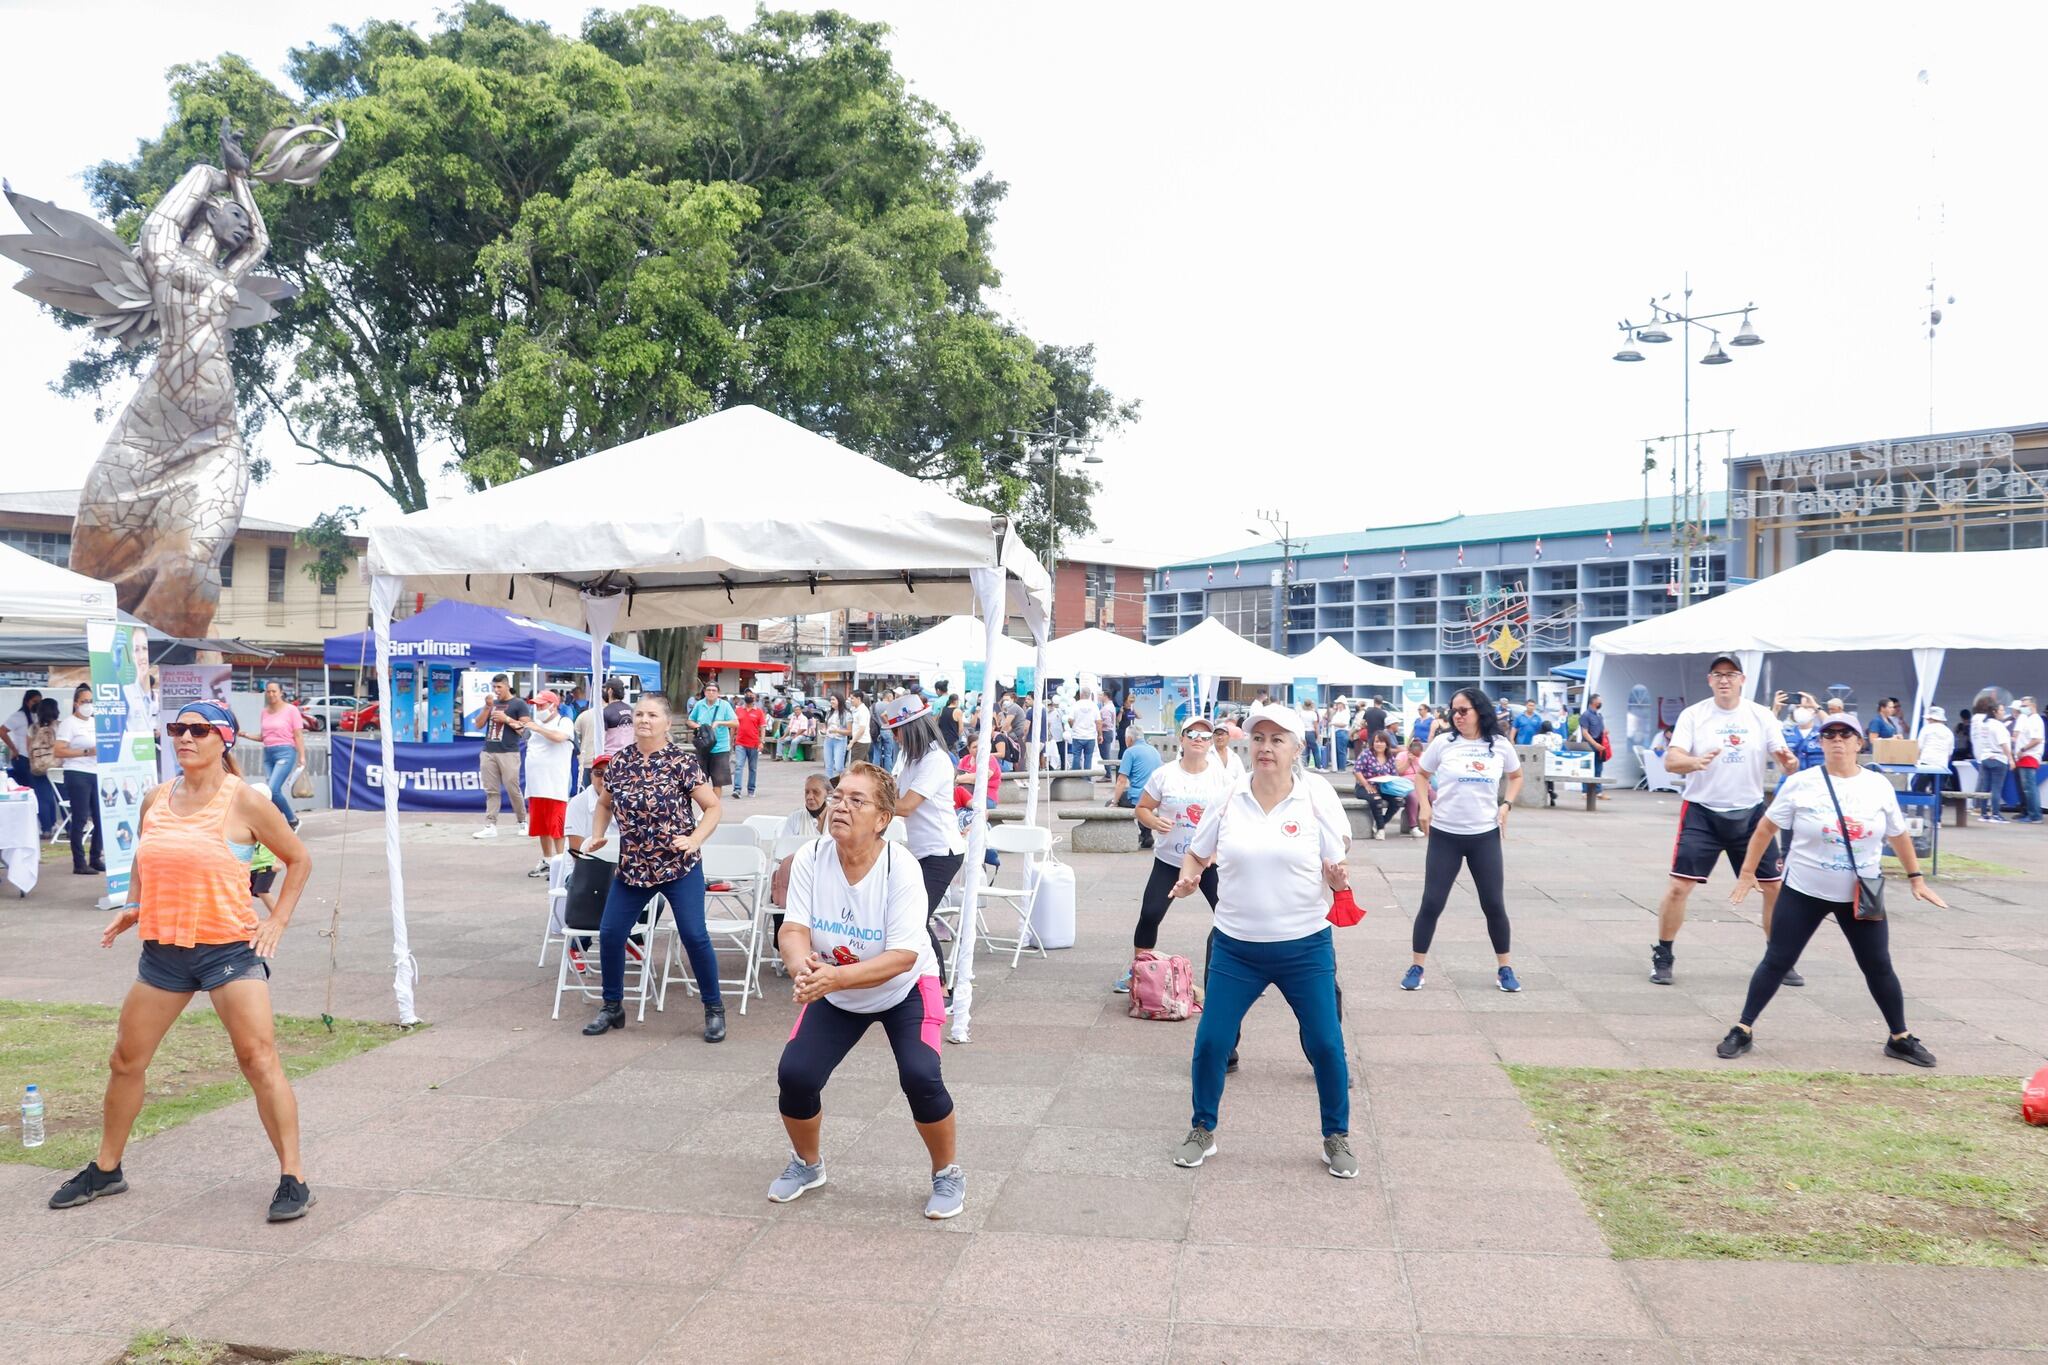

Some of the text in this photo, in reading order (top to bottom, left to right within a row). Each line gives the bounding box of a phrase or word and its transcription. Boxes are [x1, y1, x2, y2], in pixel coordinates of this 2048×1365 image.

[1761, 433, 2014, 480] Vivan Siempre
[1903, 481, 1924, 512] y
[365, 764, 484, 791] Srdima
[841, 906, 855, 923] Yo
[811, 916, 883, 941] CAMINANDO
